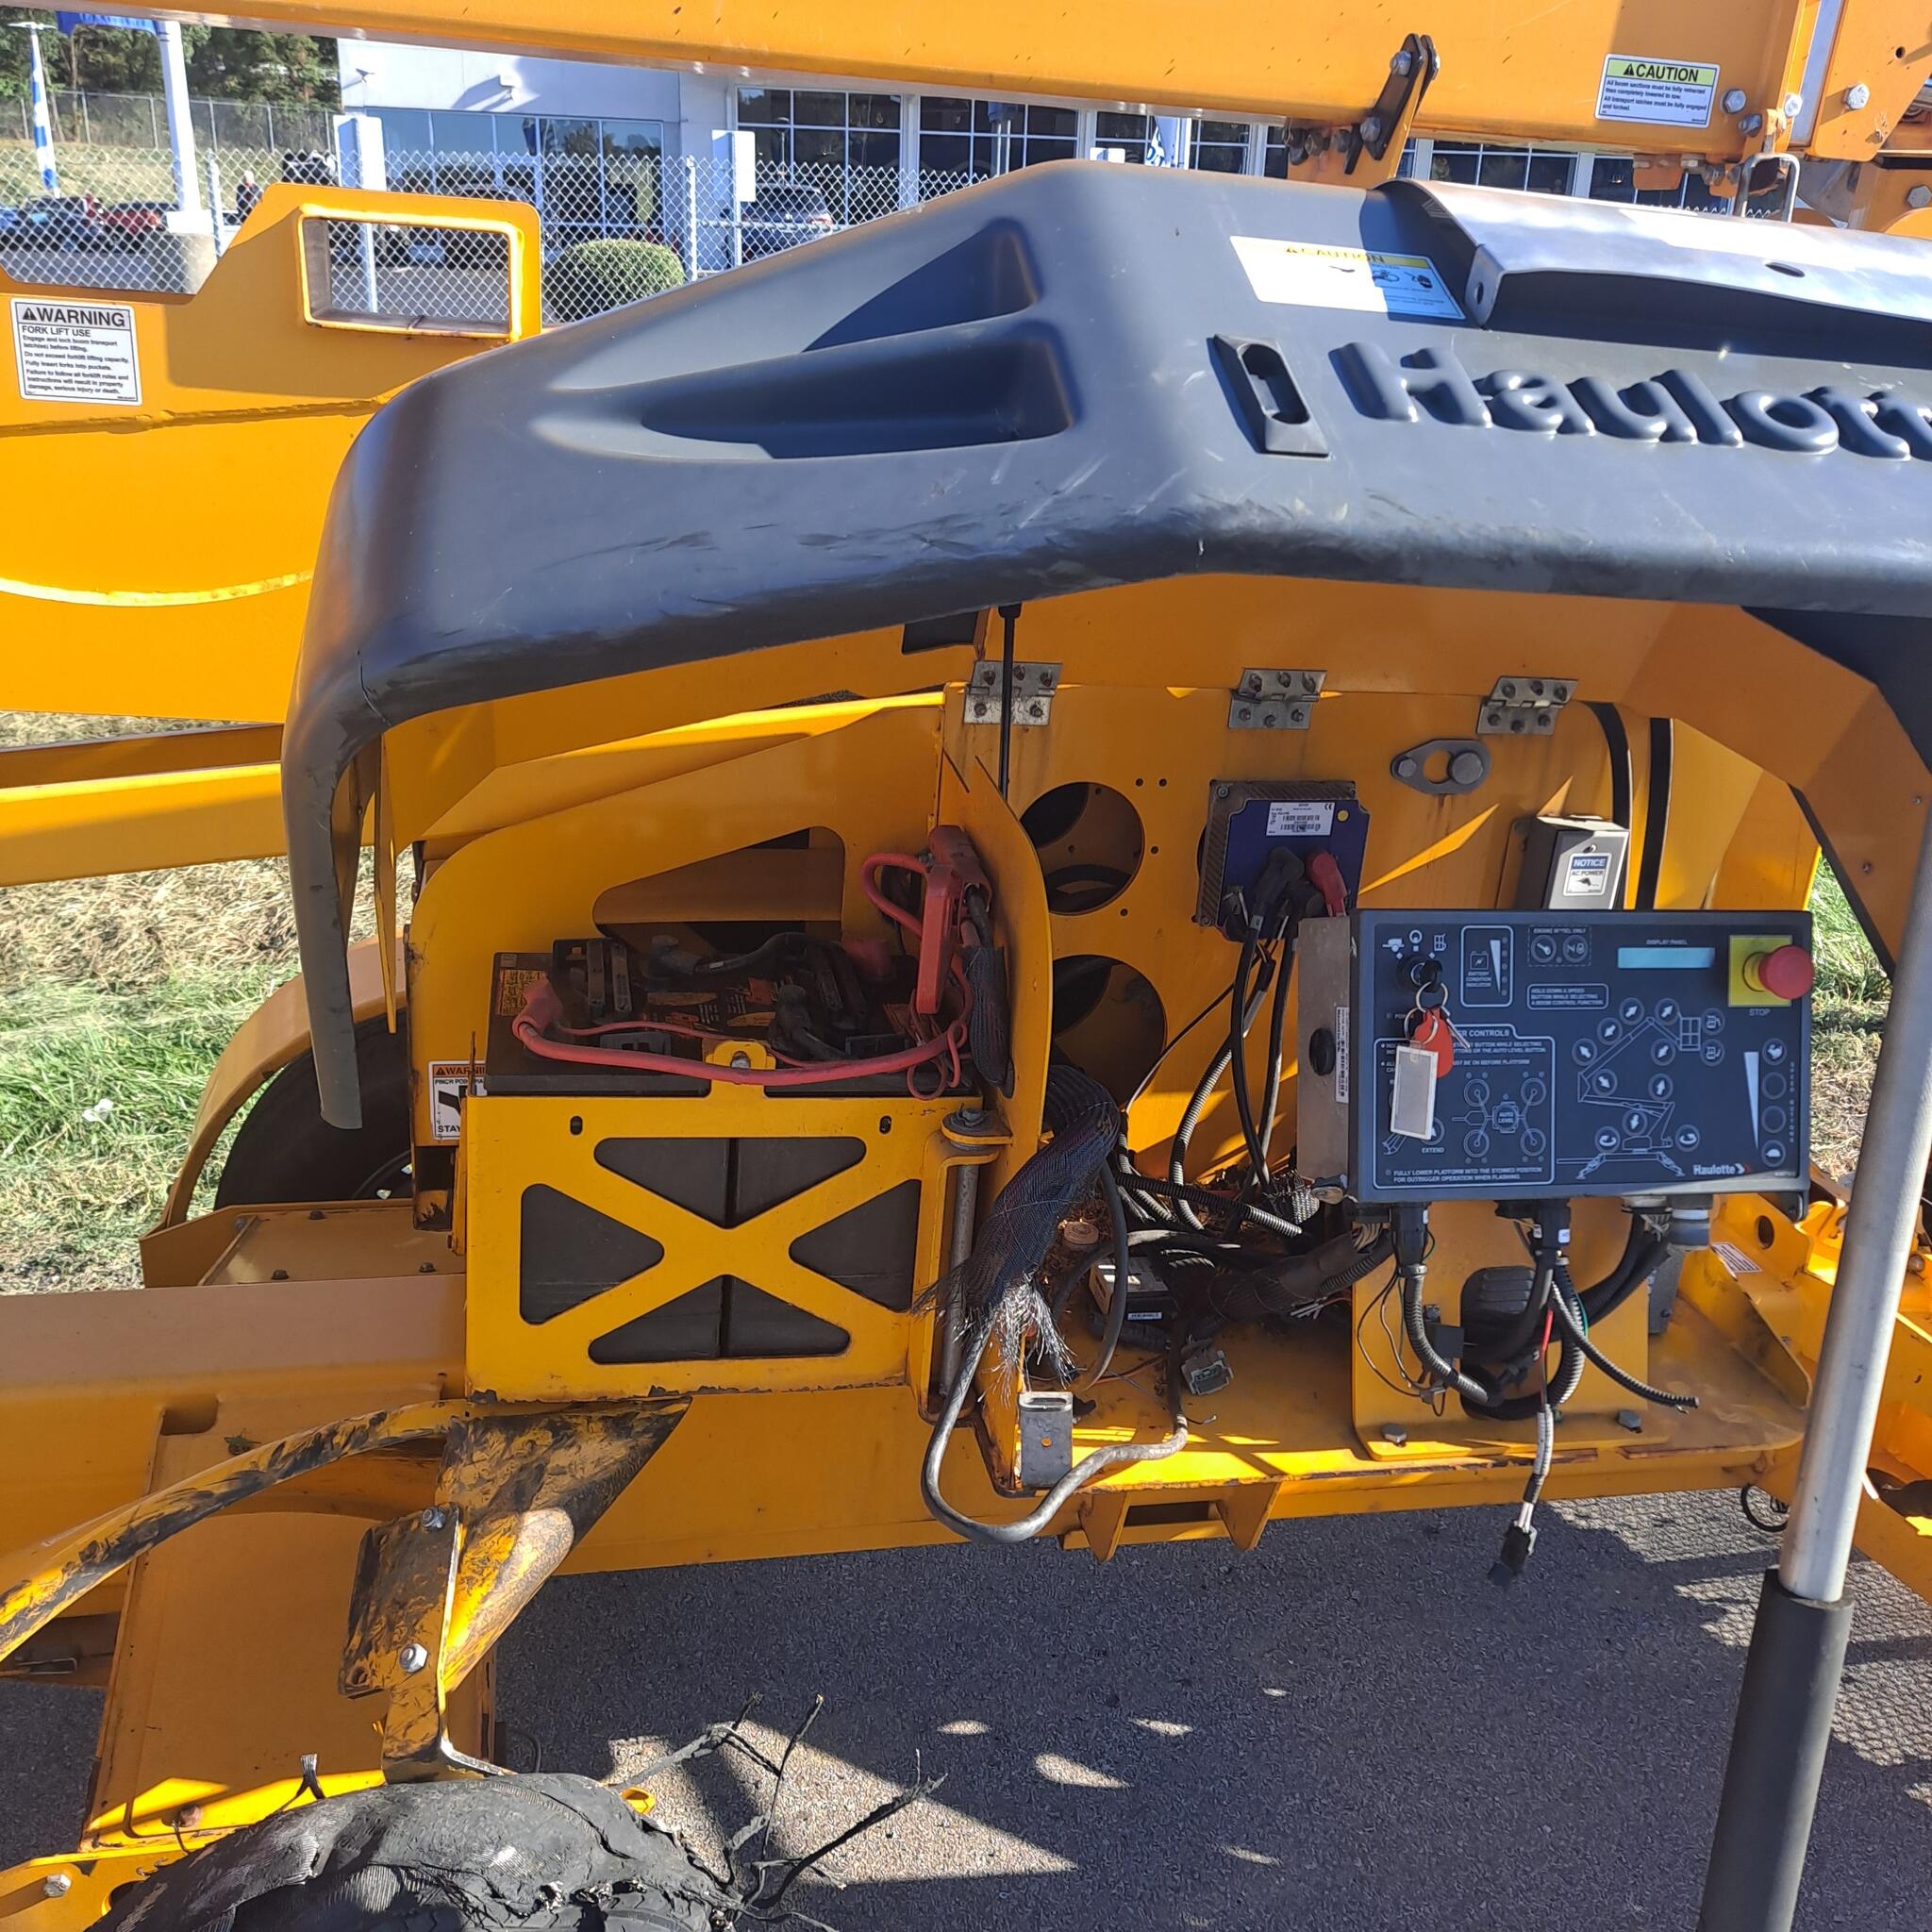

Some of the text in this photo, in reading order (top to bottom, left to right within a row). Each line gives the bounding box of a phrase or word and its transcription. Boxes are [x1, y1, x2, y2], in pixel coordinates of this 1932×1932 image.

[1636, 64, 1699, 83] CAUTION
[36, 307, 125, 327] WARNING
[23, 325, 91, 337] FORK LIFT USE
[1328, 341, 1932, 462] Haulott
[1574, 858, 1606, 867] NOTICE
[1749, 1008, 1771, 1016] STOP
[1693, 1164, 1736, 1175] Haulotte
